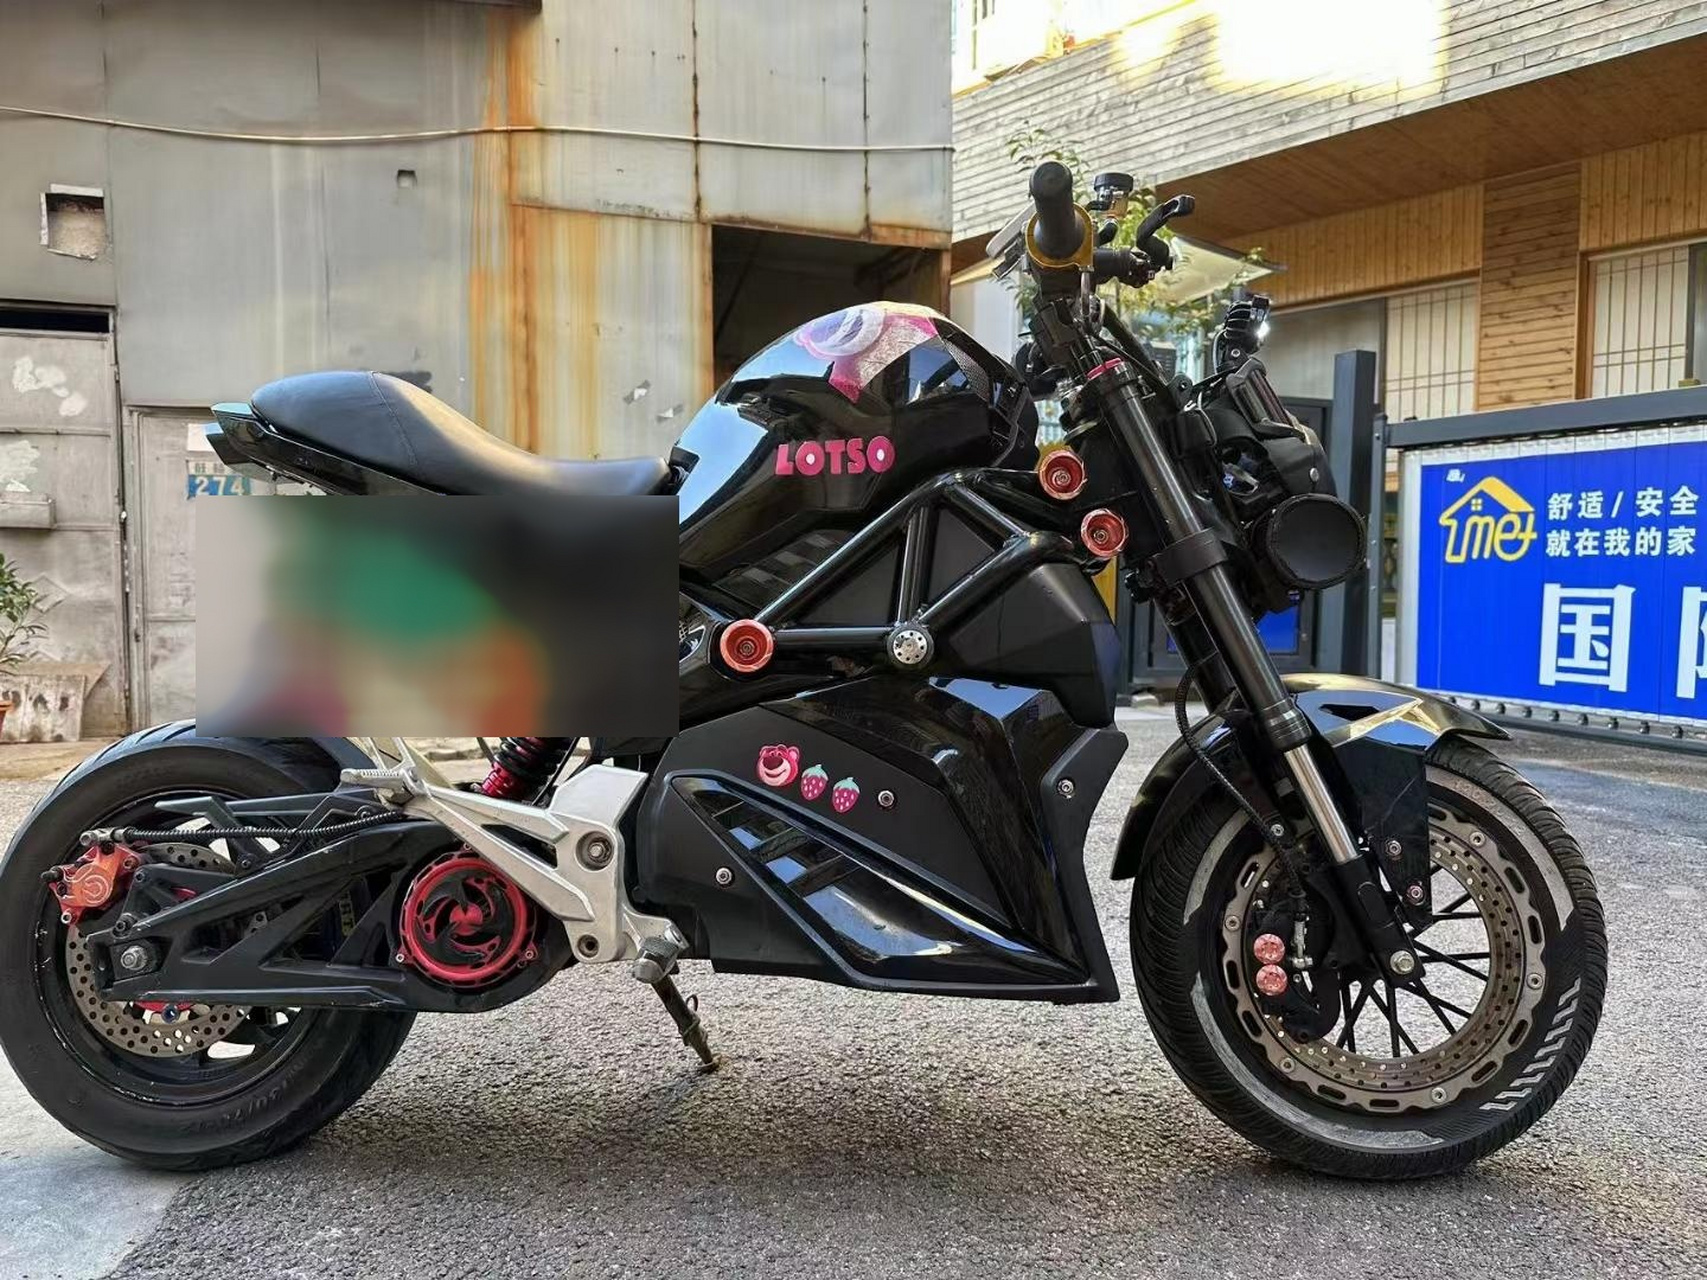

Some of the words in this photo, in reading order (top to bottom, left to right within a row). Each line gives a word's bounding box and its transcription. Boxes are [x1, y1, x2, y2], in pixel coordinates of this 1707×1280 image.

[775, 436, 895, 476] LOTSO
[194, 476, 245, 496] 274
[1547, 485, 1699, 521] 舒适/安全
[1545, 525, 1697, 558] 就在我的家
